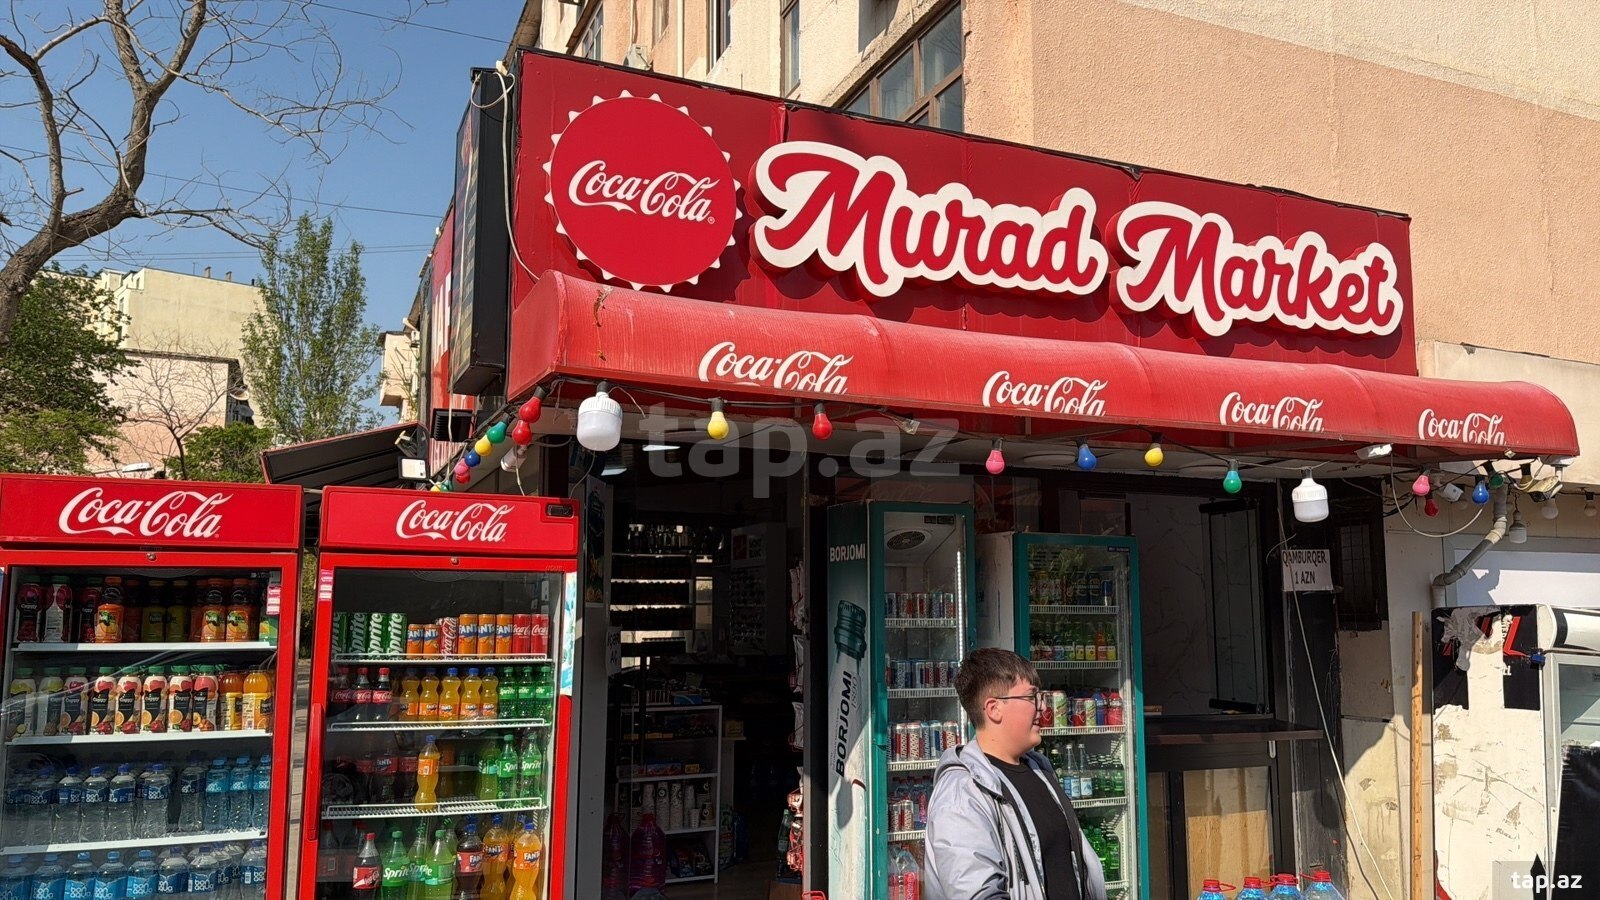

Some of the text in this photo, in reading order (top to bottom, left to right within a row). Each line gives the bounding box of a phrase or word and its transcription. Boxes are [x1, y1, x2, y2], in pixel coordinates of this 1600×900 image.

[568, 160, 720, 223] Coca-Cola
[755, 142, 1403, 335] Murad Market
[698, 341, 854, 395] Coca-Cola
[982, 370, 1109, 418] Coca-Cola
[1220, 391, 1324, 433] Coca-Cola
[1418, 408, 1507, 447] Coca-Cola
[58, 487, 234, 538] Coca-Cola
[395, 499, 516, 543] Coca-Cola
[829, 544, 866, 562] BORJOMI
[1282, 550, 1327, 568] QAMBURQER
[1295, 571, 1316, 584] 1 AZN
[368, 612, 383, 658] Sprite
[387, 612, 403, 658] Sprite
[836, 671, 852, 778] BORJOMI
